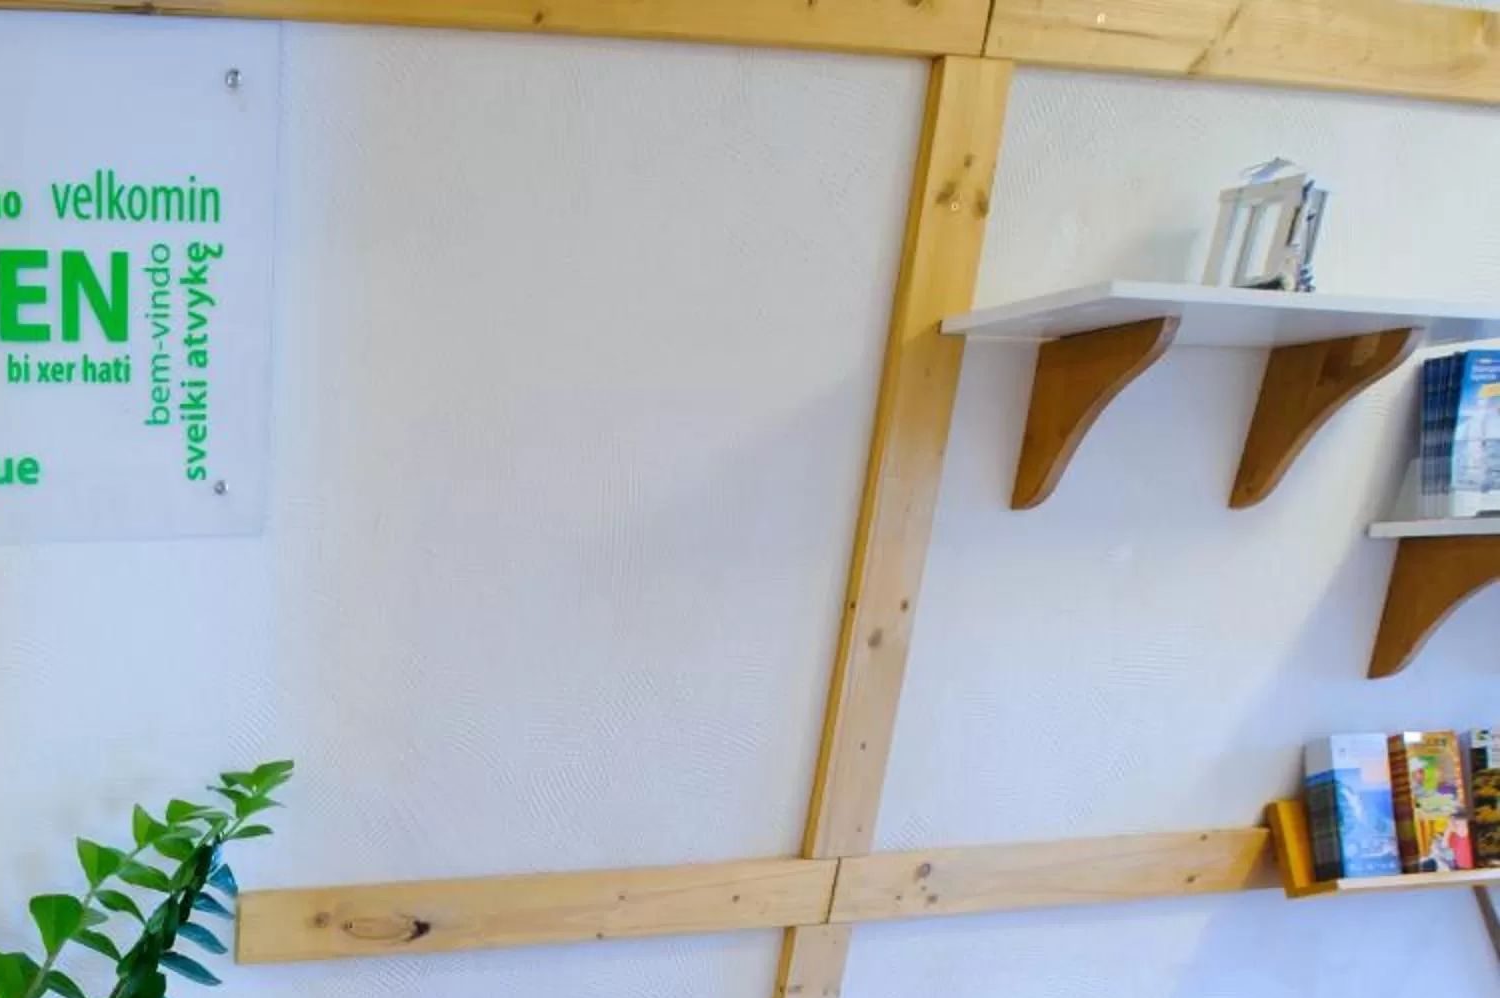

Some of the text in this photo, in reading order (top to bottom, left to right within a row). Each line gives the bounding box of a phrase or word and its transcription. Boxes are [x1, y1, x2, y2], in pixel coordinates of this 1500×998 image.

[51, 170, 222, 222] velkomin
[6, 354, 132, 384] bi xer hati
[142, 242, 172, 426] bem-vindo
[179, 379, 208, 482] sveiki
